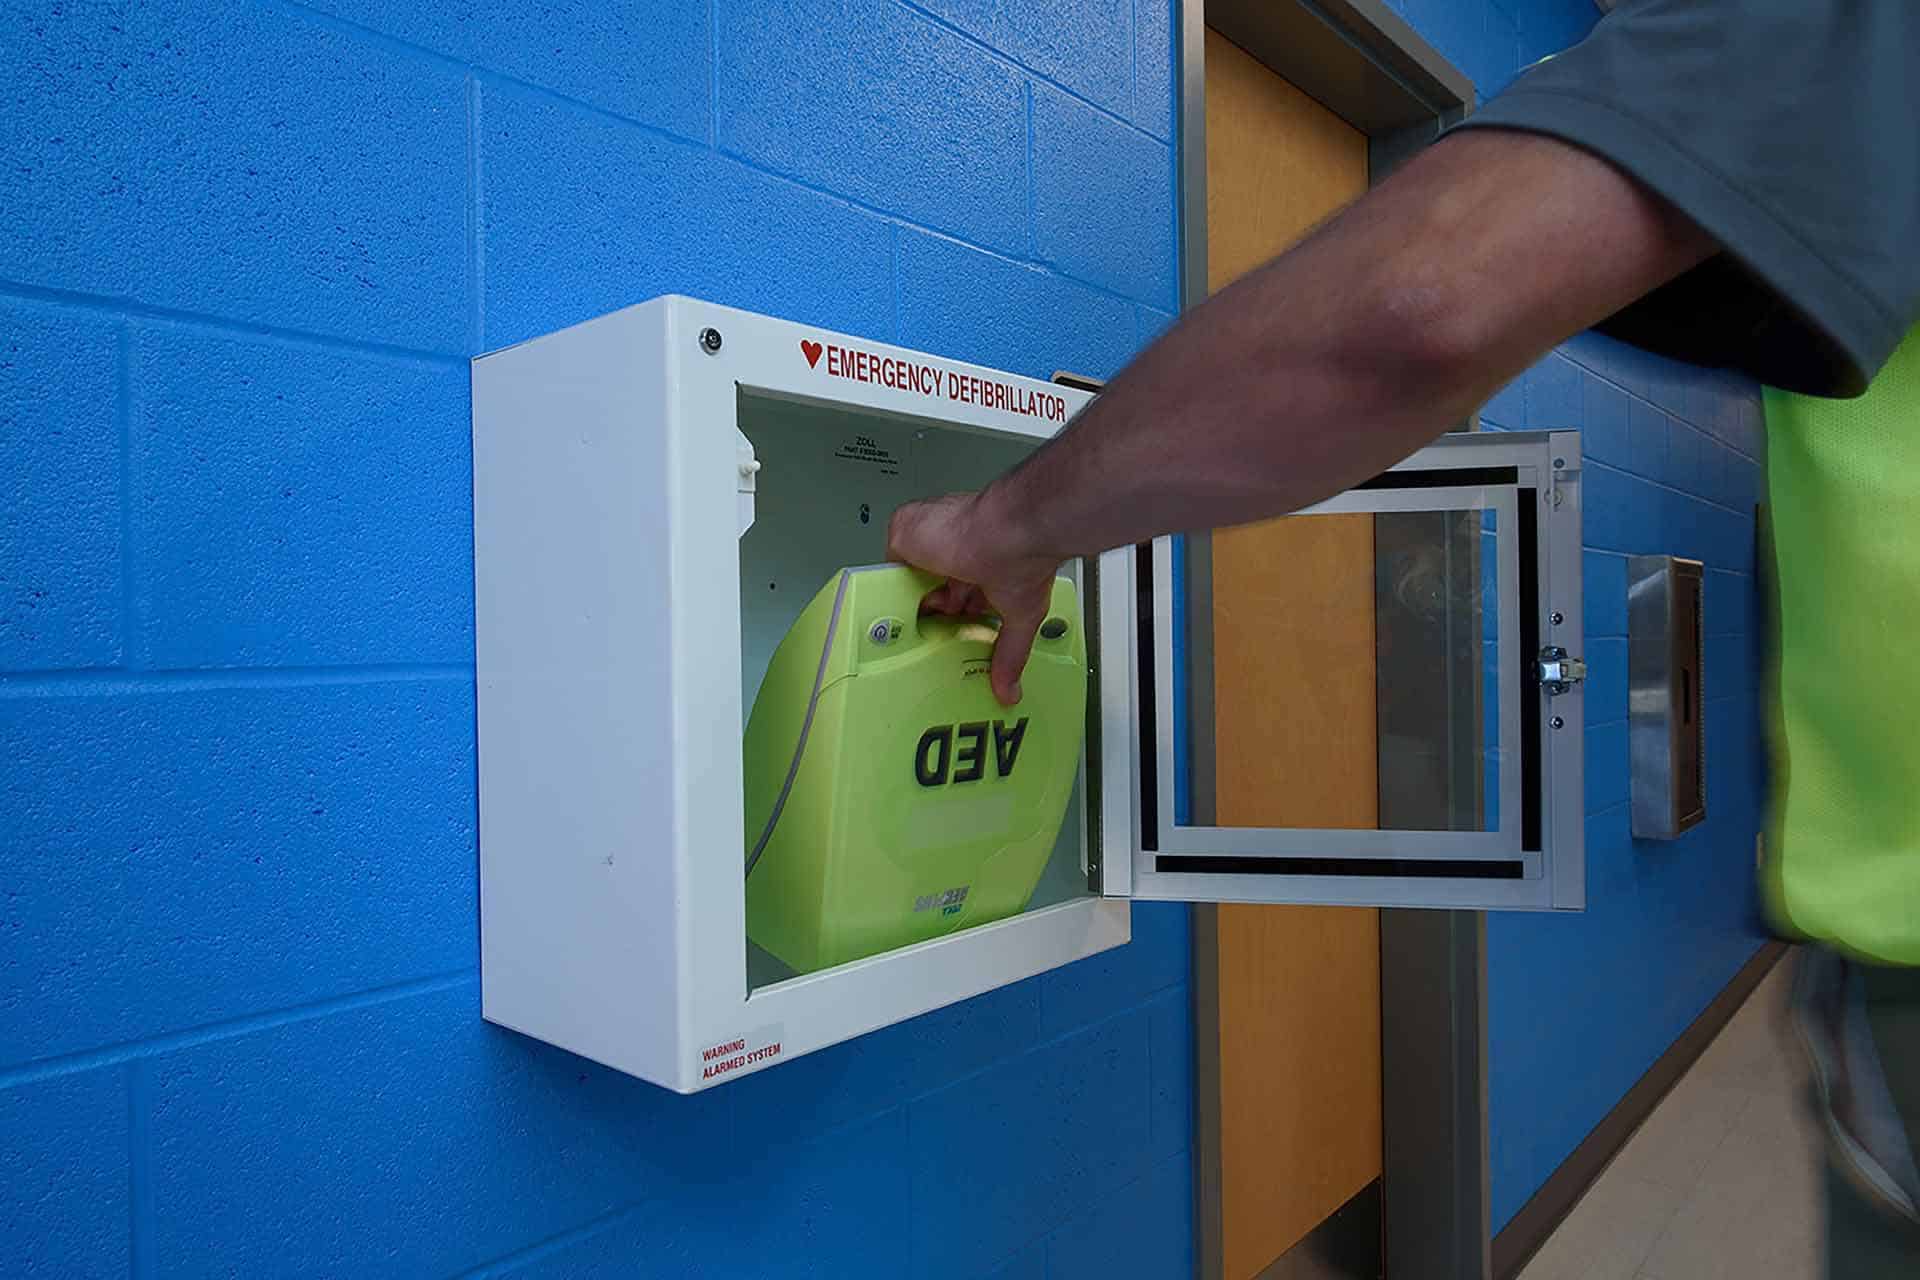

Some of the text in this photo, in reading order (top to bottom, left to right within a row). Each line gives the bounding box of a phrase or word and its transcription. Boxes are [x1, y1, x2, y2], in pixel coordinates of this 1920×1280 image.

[827, 345, 1066, 422] EMERGENCY DEFIBRILLATOR
[914, 717, 1030, 787] AED
[703, 1039, 745, 1061] WARNING
[703, 1043, 781, 1080] ALARMED SYSTEM
